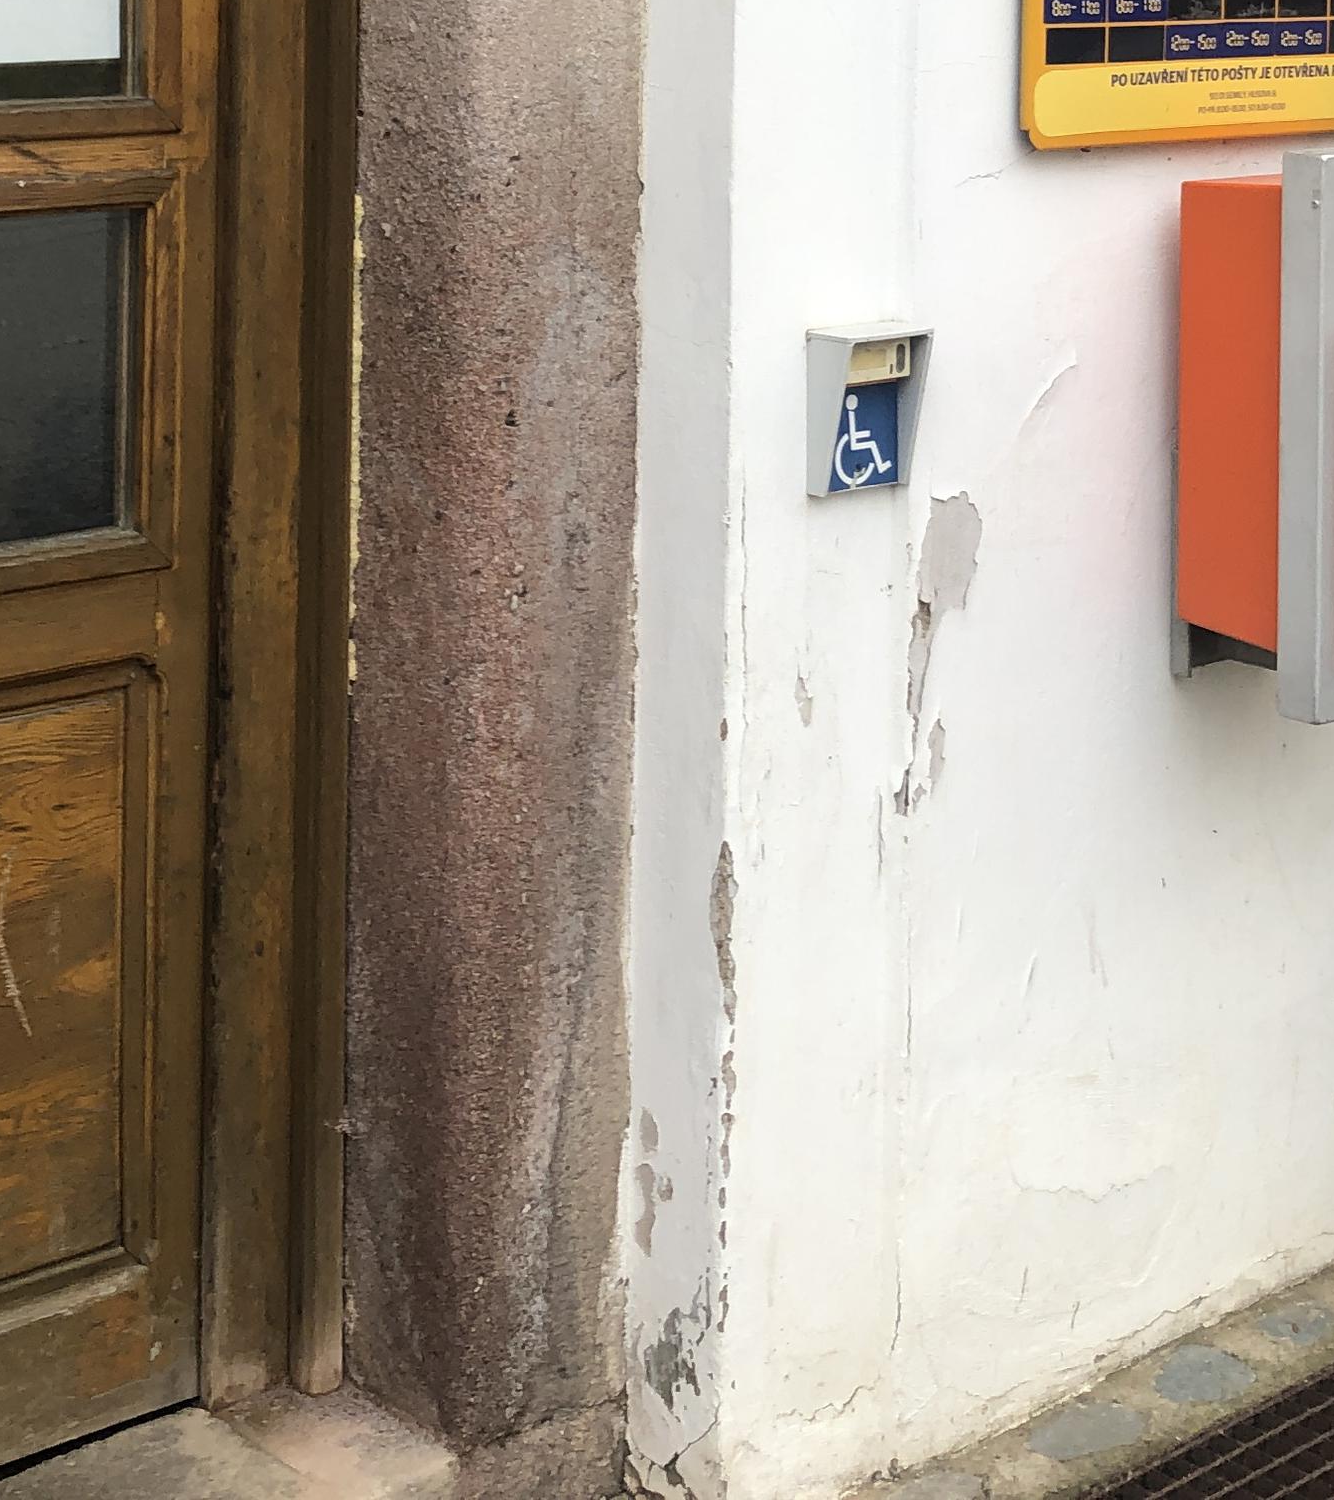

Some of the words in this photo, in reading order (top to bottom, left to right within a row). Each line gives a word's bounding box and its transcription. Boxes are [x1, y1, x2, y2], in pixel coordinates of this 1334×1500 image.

[1111, 73, 1127, 87] PO
[1130, 68, 1188, 86] UZAVŘENÍ
[1190, 66, 1218, 82] TÉTO
[1221, 65, 1257, 81] POŠTY
[1259, 66, 1272, 80] JE
[1273, 63, 1330, 79] OTEVŘENA
